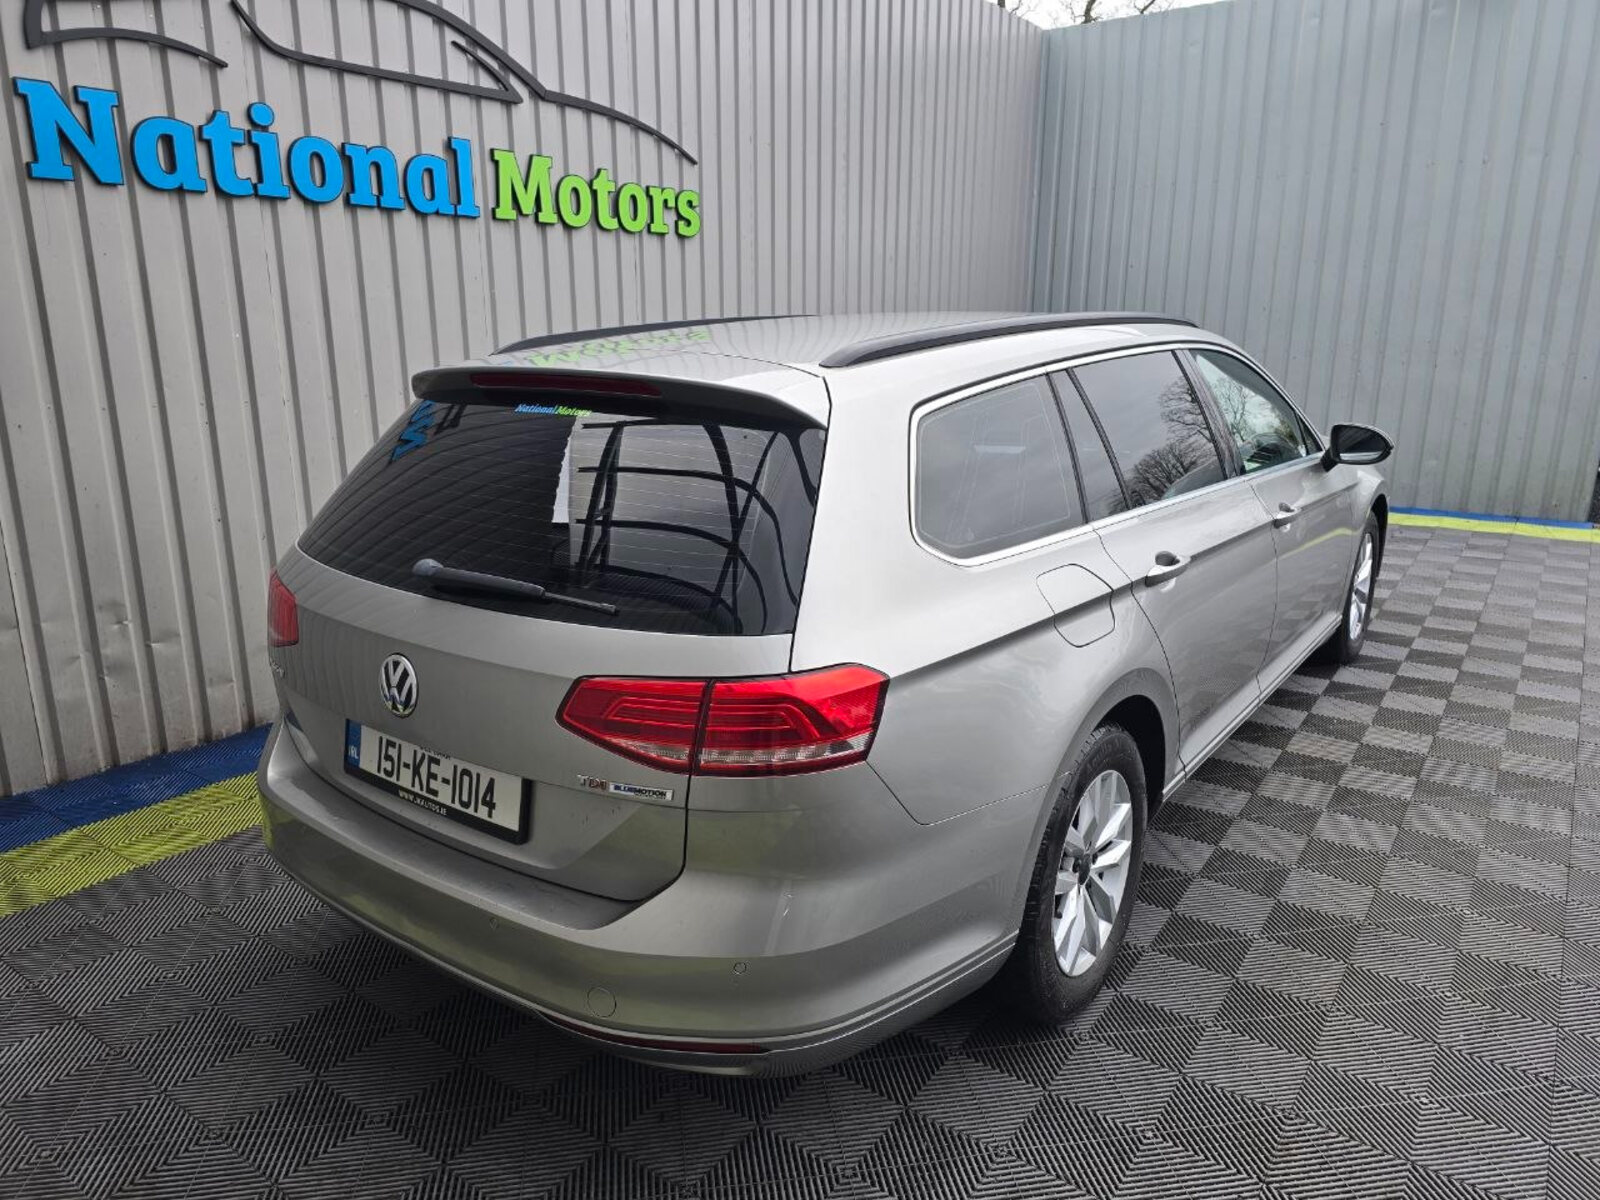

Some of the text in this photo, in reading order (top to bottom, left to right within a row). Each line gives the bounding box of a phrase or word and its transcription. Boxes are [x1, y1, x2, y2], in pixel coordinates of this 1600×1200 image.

[13, 76, 701, 239] National Motors
[376, 735, 497, 819] 151-KE-1014
